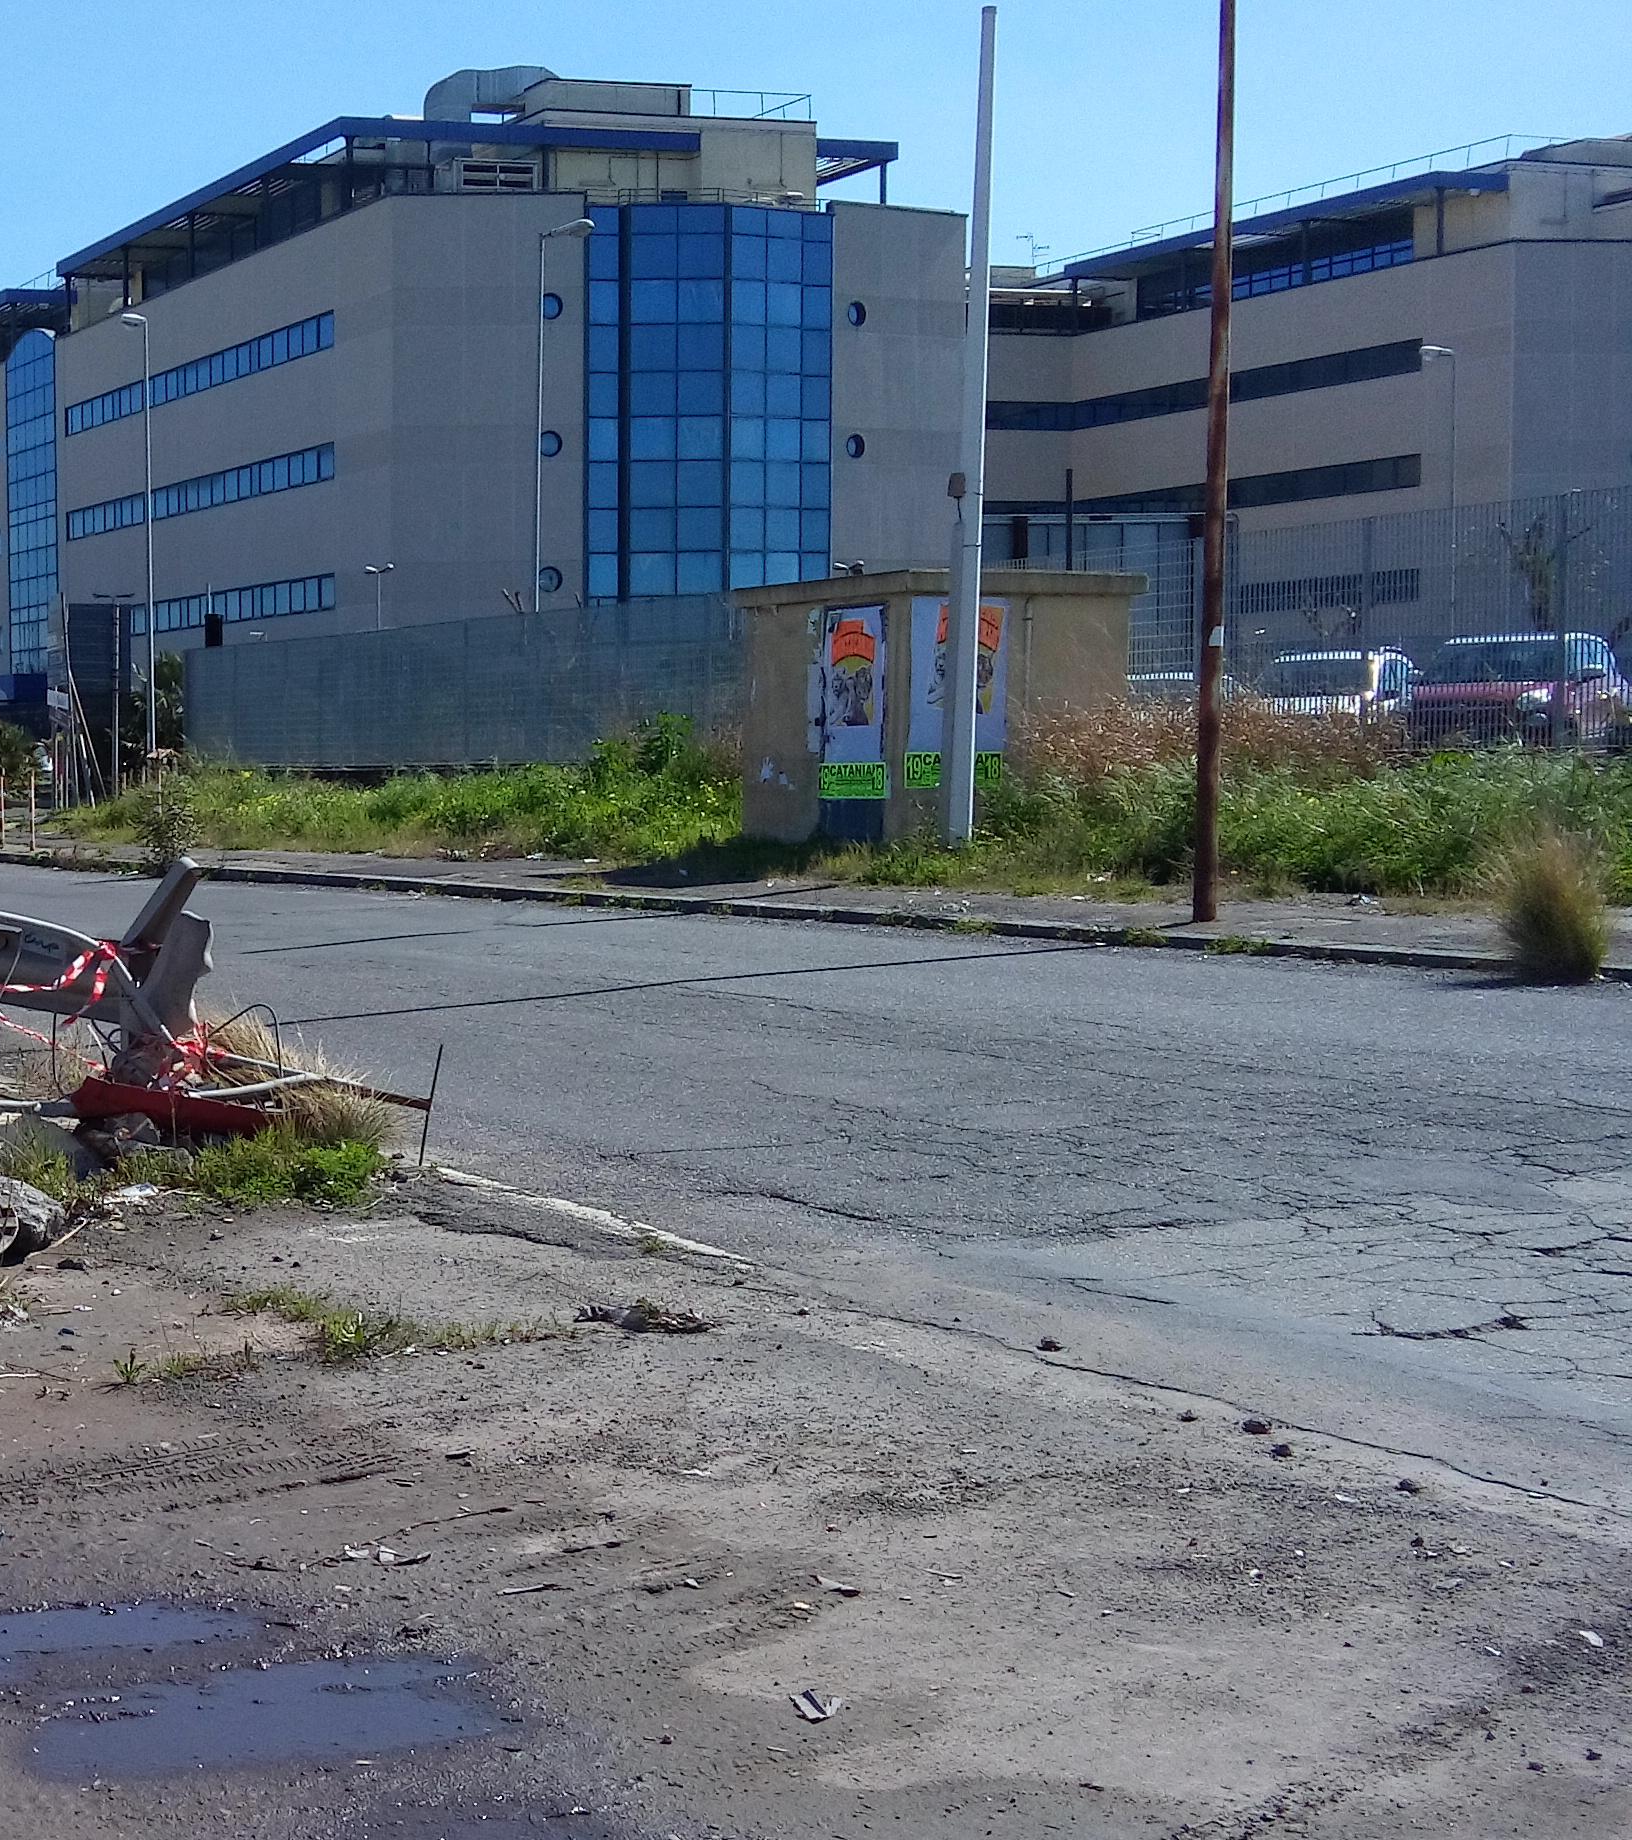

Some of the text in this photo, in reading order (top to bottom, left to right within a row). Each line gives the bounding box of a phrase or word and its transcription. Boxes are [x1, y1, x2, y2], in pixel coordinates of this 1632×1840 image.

[820, 765, 883, 790] 19 CATANIA 18
[907, 754, 921, 779] 19
[986, 754, 999, 779] 18
